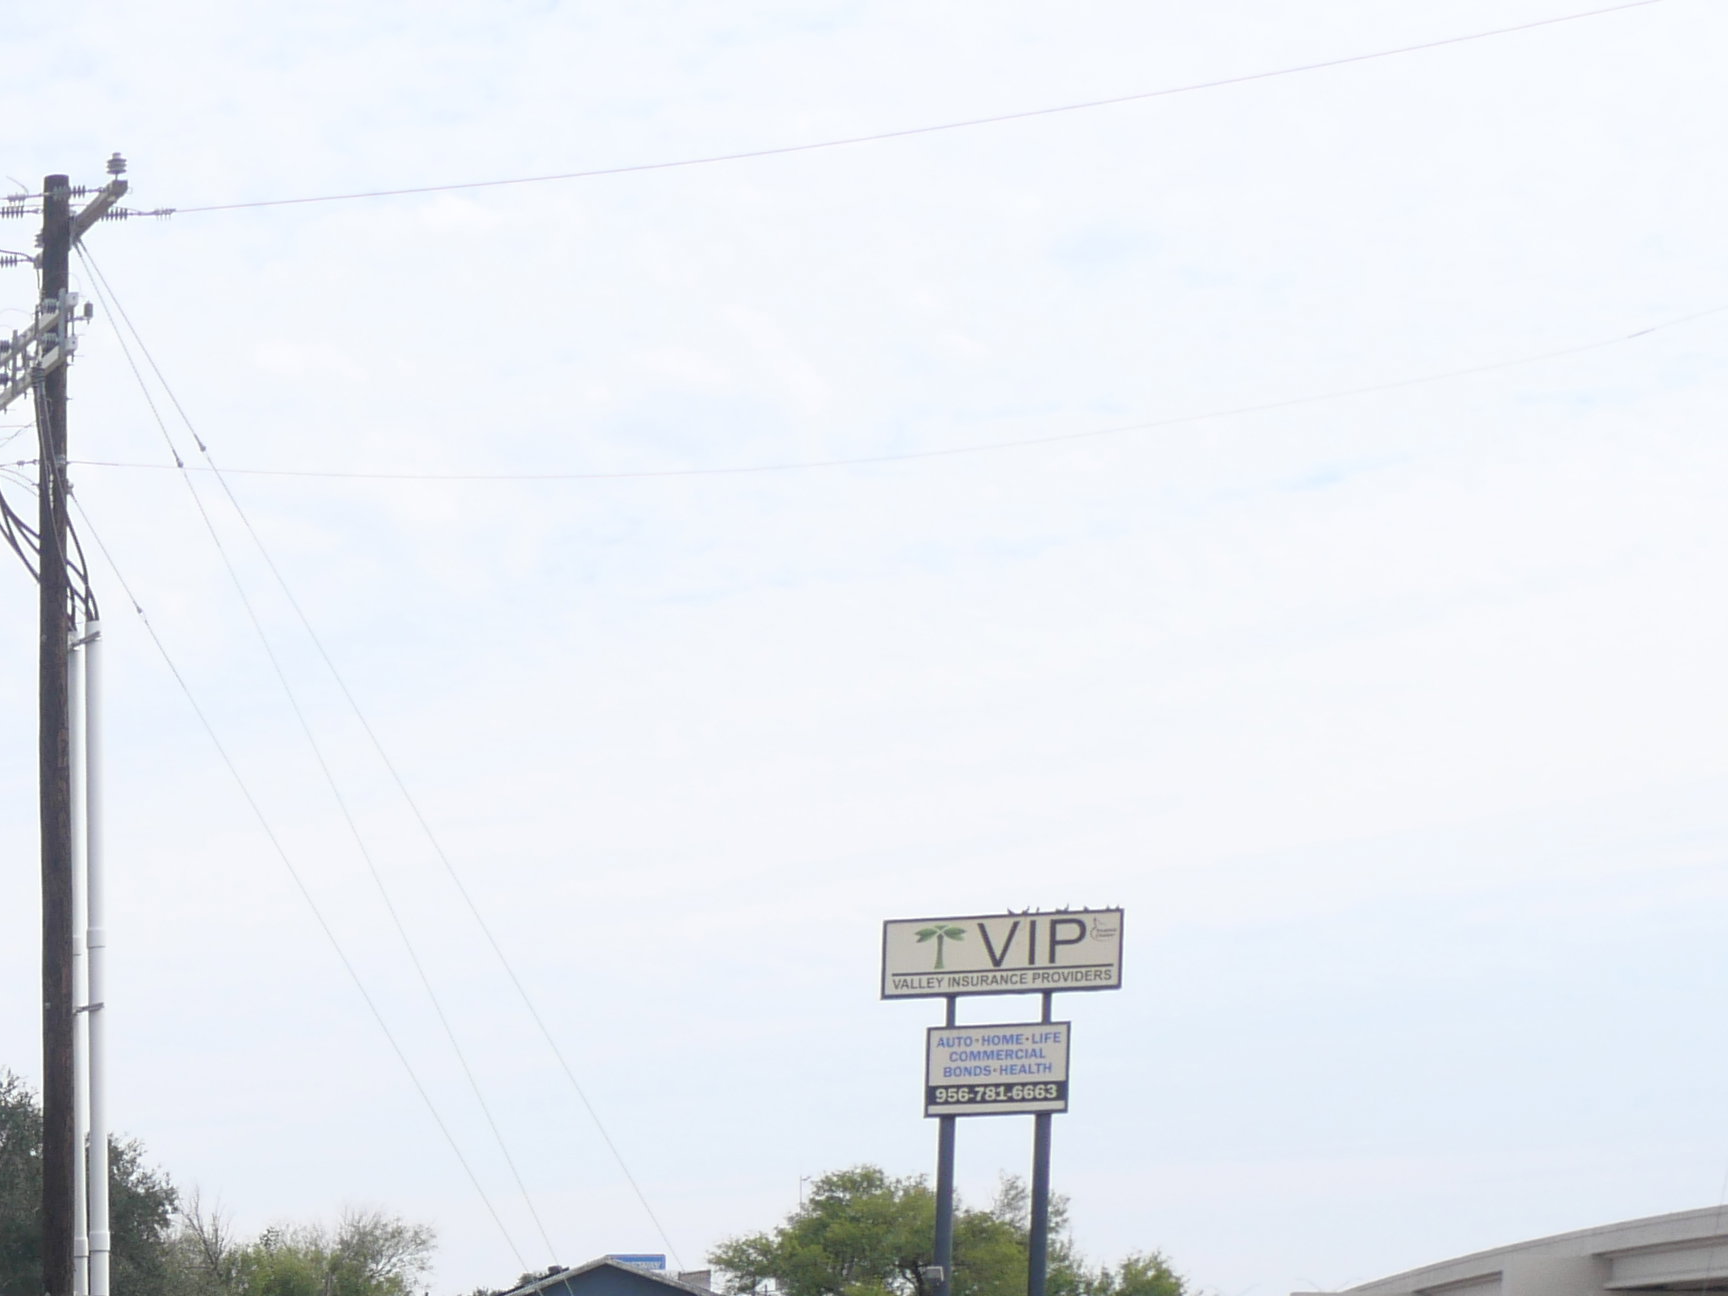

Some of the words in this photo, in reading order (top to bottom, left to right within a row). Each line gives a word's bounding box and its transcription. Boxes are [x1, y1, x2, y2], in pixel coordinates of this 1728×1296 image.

[977, 917, 1087, 968] VIP
[892, 976, 945, 990] VALLEY
[947, 972, 1029, 988] INSURANCE
[1031, 968, 1113, 984] PROVIDERS
[936, 1036, 974, 1048] AUTO
[981, 1033, 1024, 1046] HOME
[1031, 1031, 1062, 1044] LIFE
[949, 1048, 1046, 1062] COMMERCIAL
[943, 1065, 992, 1078] BONDS
[999, 1062, 1053, 1076] HEALTH
[935, 1083, 1058, 1103] 956-781-6663
